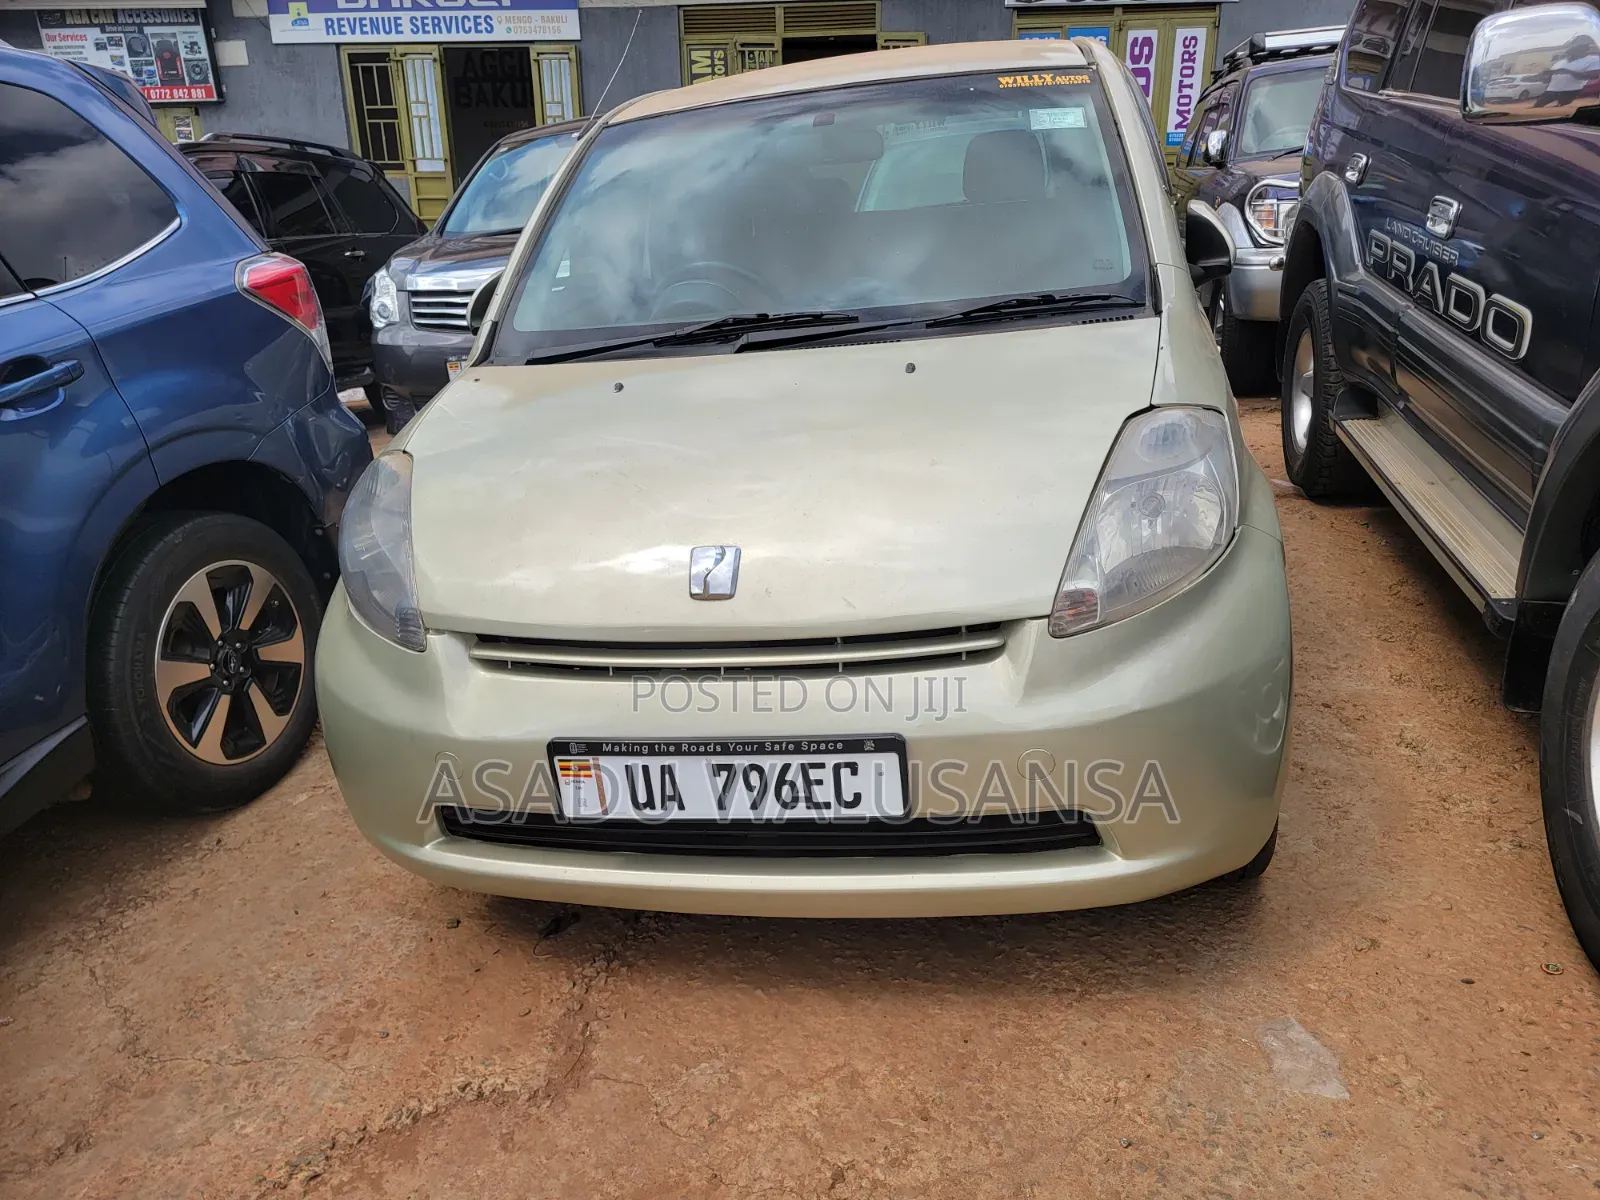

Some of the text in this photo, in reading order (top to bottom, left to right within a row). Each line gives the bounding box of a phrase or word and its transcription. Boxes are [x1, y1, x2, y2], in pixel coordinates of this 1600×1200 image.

[117, 9, 196, 25] ACCESSORIES
[324, 14, 495, 36] REVENUE SERVICES
[504, 16, 533, 24] MENGO
[540, 15, 568, 24] BAKULI
[45, 32, 88, 43] Our Services
[997, 73, 1054, 85] WILLY
[1174, 35, 1198, 131] MOTORS
[150, 89, 171, 99] 0772
[173, 88, 189, 99] 842
[1386, 217, 1459, 267] LAND CRUISER
[1366, 228, 1533, 362] PRADO
[602, 742, 651, 755] Making
[654, 742, 677, 752] the
[681, 742, 723, 752] Roads
[727, 741, 758, 752] Your
[764, 741, 798, 752] Safe
[801, 740, 844, 754] Space
[624, 760, 862, 812] UA 796EC
